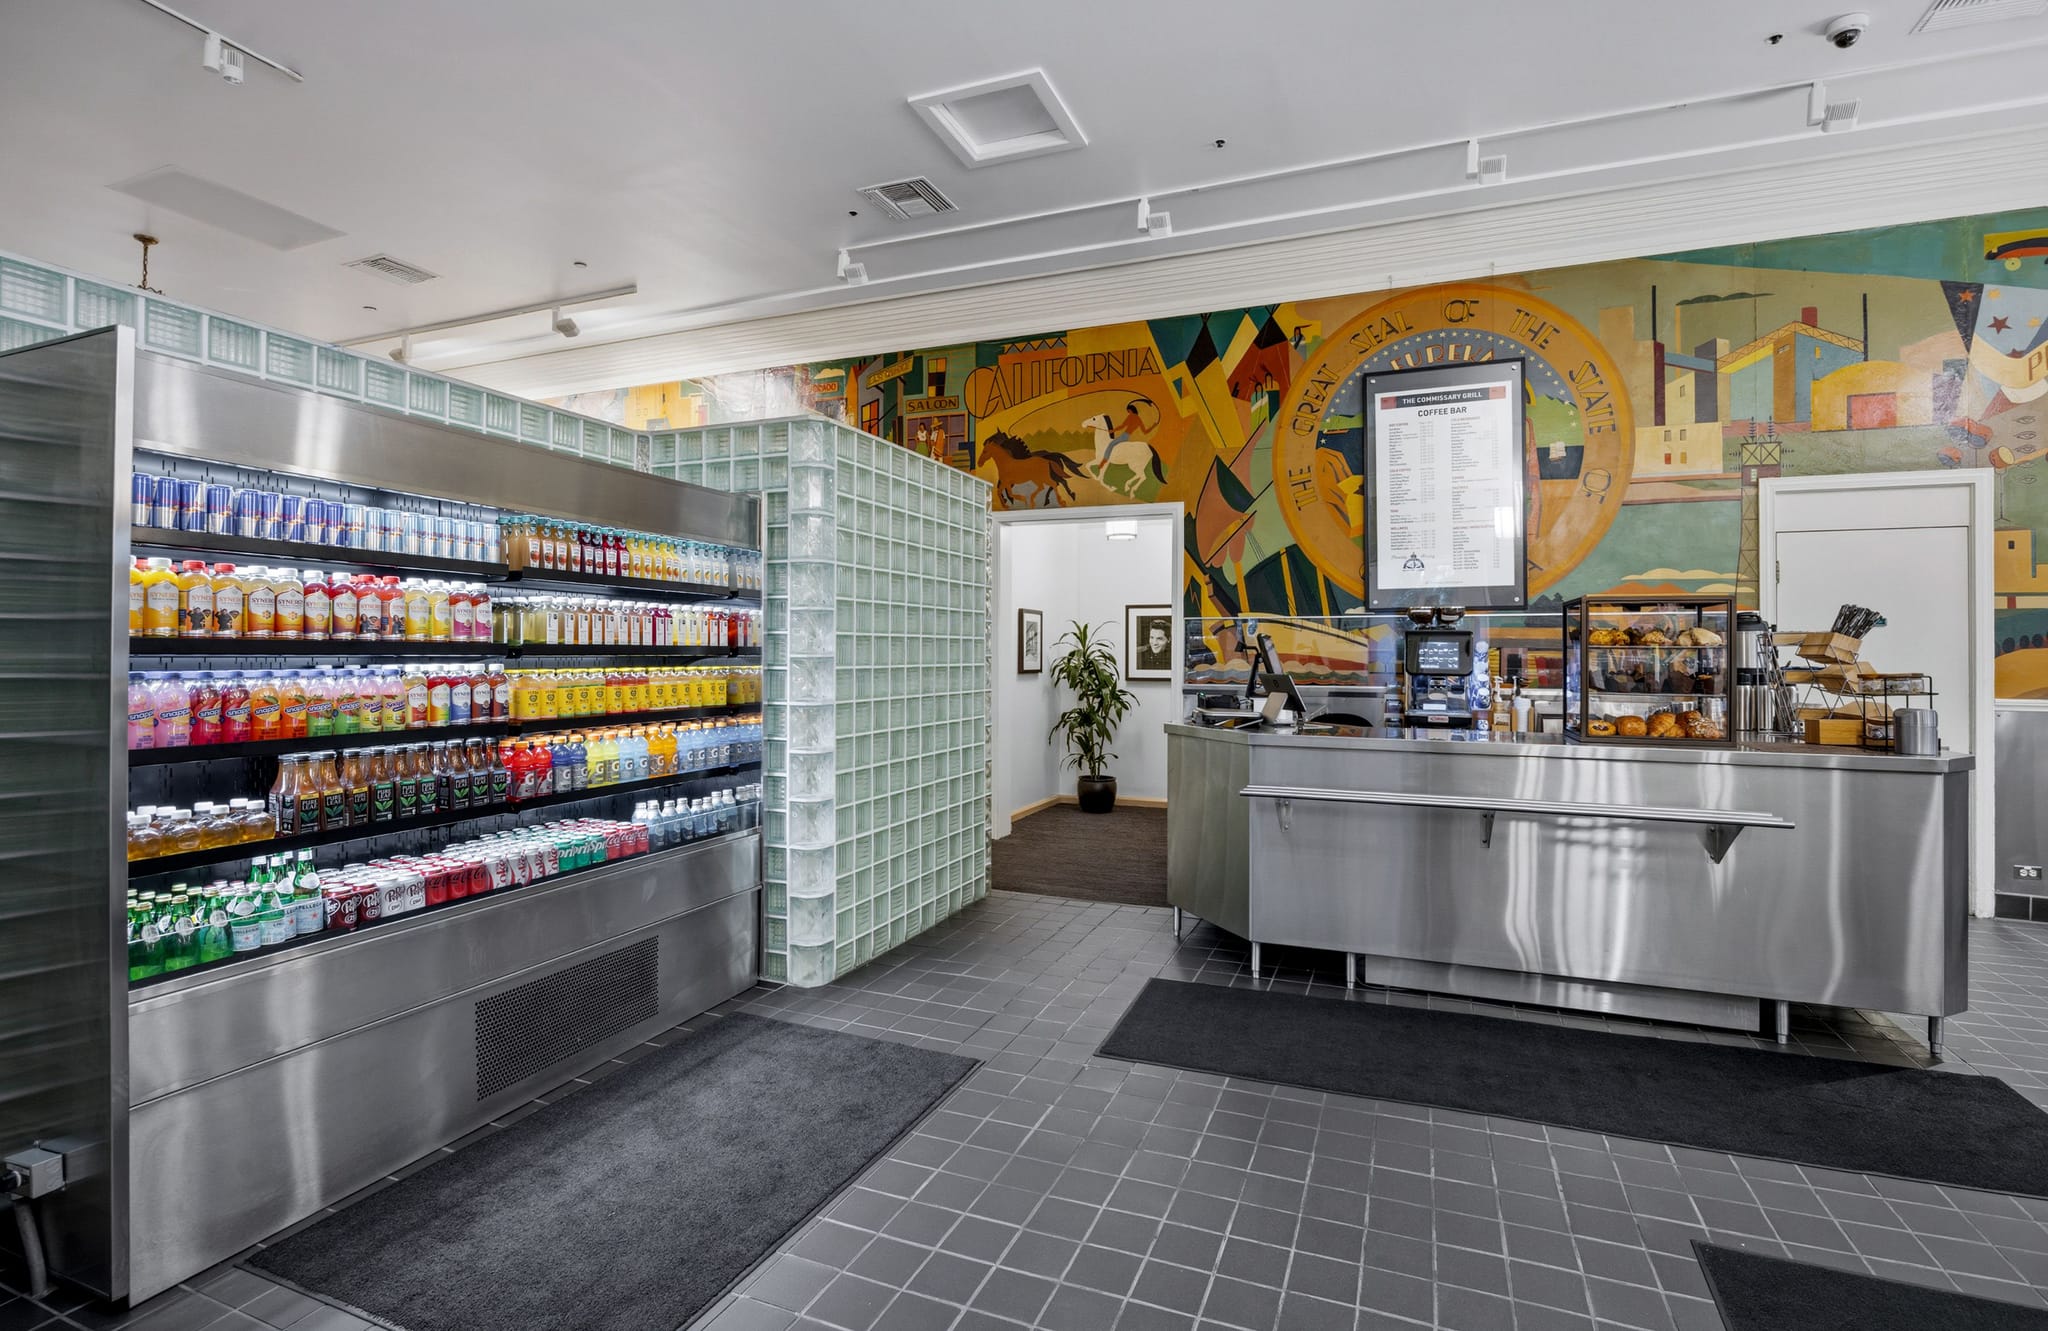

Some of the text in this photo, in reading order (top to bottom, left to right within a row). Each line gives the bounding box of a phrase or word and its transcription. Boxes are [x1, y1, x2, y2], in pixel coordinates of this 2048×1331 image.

[1390, 343, 1495, 371] EUREKA
[964, 346, 1162, 420] CALIFORNIA
[1402, 391, 1483, 405] THE COMMISSARY GRILL
[907, 398, 958, 413] SALOON
[1288, 299, 1617, 511] THE GREAT SEAL OF THE STATE OF
[1417, 406, 1468, 417] COFFEE BAR
[596, 763, 604, 774] G
[611, 760, 620, 772] G
[625, 760, 633, 770] G
[639, 757, 648, 768] G
[525, 772, 535, 786] G
[563, 768, 571, 780] G
